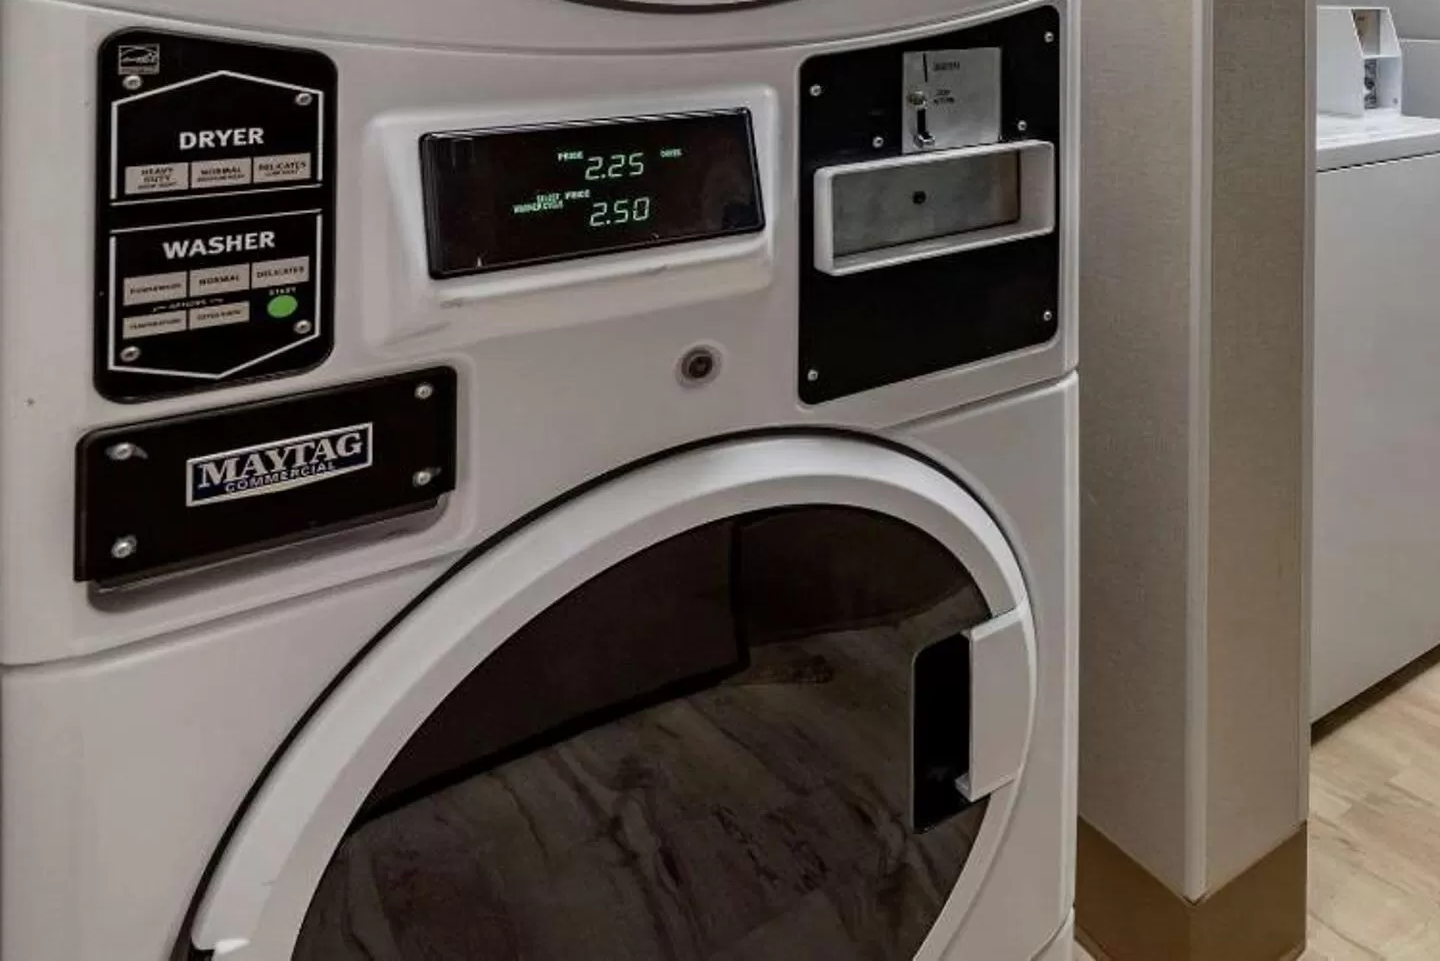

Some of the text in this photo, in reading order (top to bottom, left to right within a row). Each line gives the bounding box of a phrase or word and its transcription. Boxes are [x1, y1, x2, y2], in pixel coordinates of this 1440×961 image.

[179, 127, 264, 150] DRYER
[557, 150, 584, 162] PRICE
[585, 152, 644, 181] 2.25
[565, 189, 591, 200] PRICE
[589, 197, 650, 226] 2.50
[162, 231, 276, 259] WASHER
[199, 274, 240, 286] NORMAL
[197, 432, 364, 488] MAYTAG
[225, 461, 337, 493] COMMERCIAL
